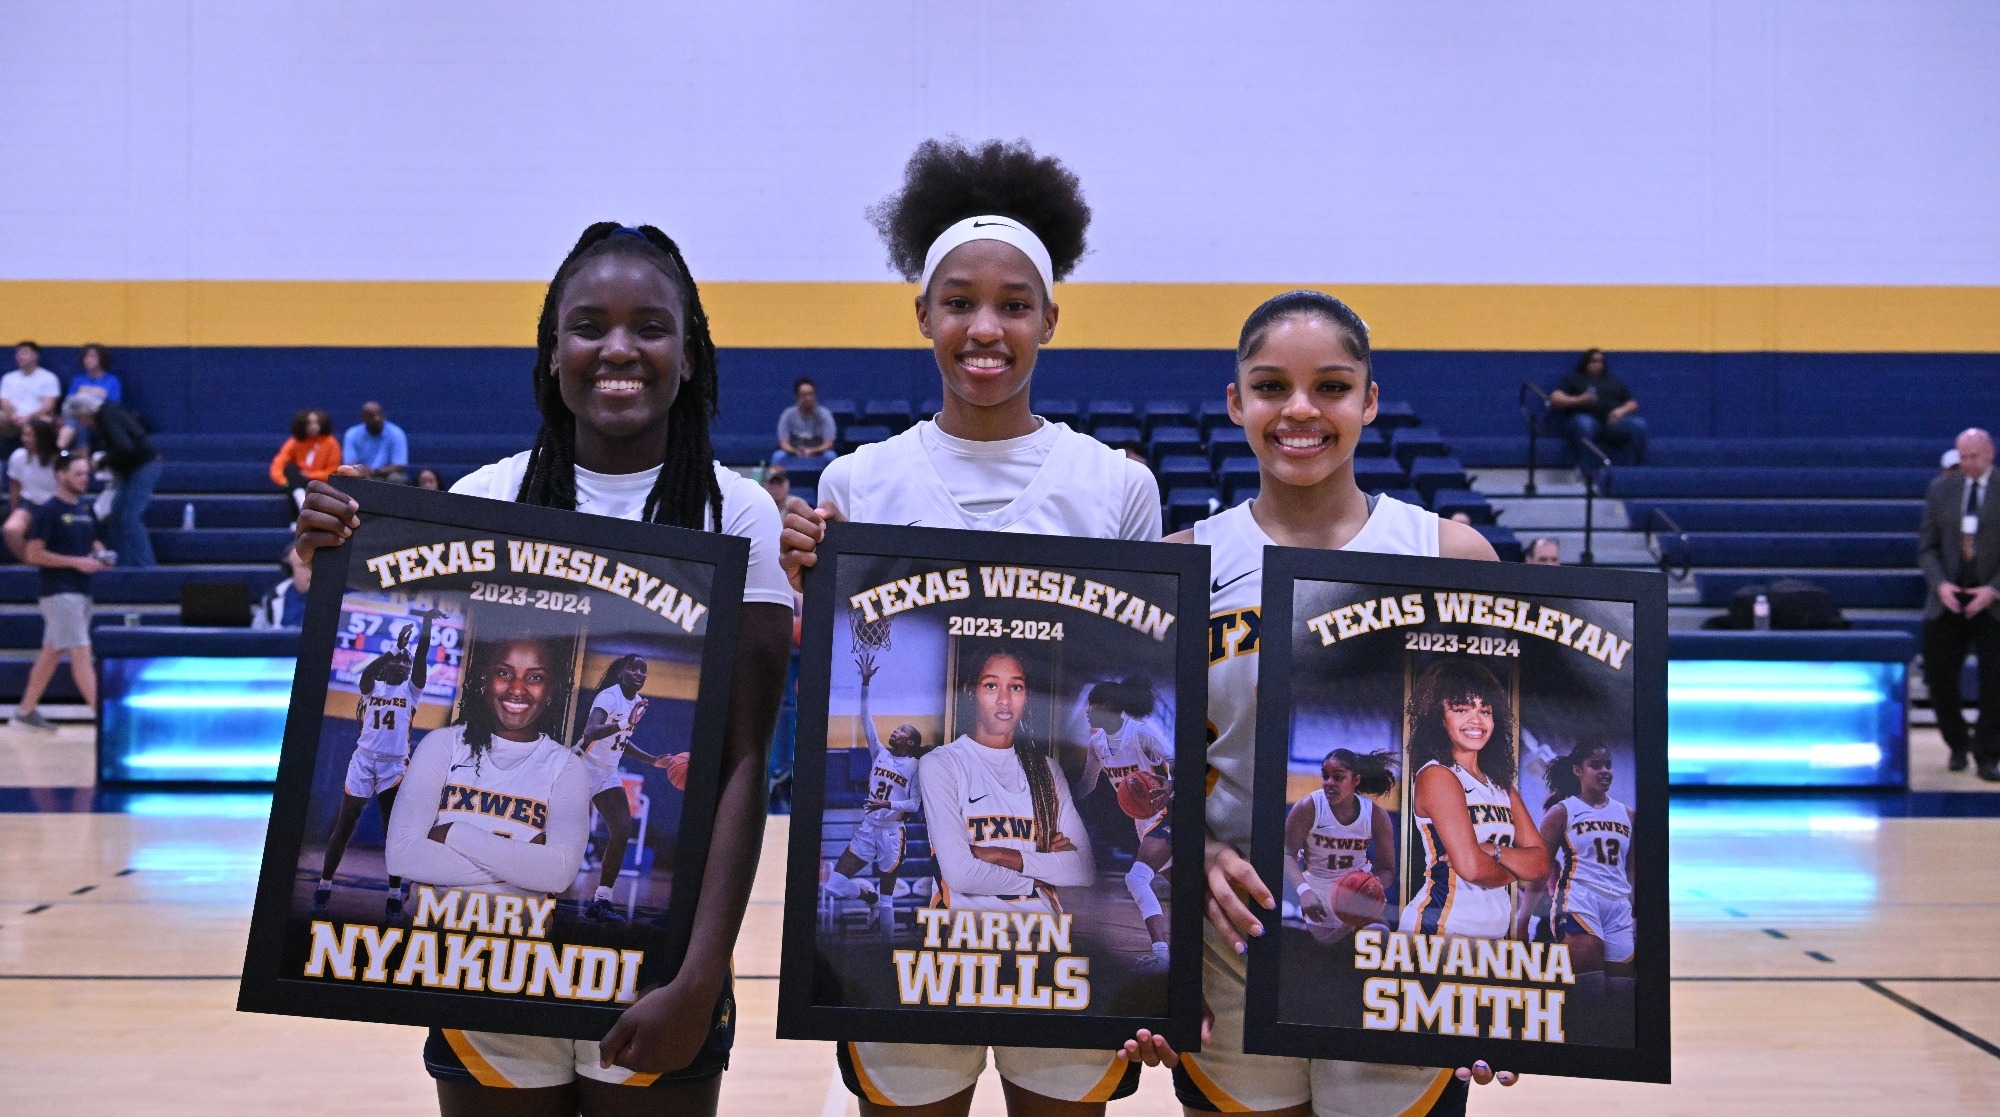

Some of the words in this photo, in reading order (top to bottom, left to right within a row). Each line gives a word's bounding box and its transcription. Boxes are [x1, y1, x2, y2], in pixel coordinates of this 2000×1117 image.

[367, 540, 495, 588] TEXAS
[508, 540, 706, 633] WESLEYAN
[470, 581, 591, 614] 2023-2024
[850, 568, 969, 623] TEXAS
[979, 567, 1176, 642] WESLEYAN
[348, 612, 383, 636] 57
[949, 616, 1064, 641] 2023-2024
[1307, 593, 1425, 647] TEXAS
[1433, 592, 1632, 670] WESLEYAN
[1405, 632, 1520, 657] 2023-2024
[373, 709, 395, 731] 14
[874, 766, 908, 788] TXWES
[876, 781, 893, 800] 21
[438, 783, 548, 832] TXWES
[1572, 820, 1630, 838] TXWES
[1594, 837, 1620, 866] 12
[413, 886, 556, 938] MARY
[916, 908, 1072, 953] TARYN
[304, 920, 644, 1004] NYAKUNDI
[1354, 929, 1576, 984] SAVANNA
[893, 949, 1090, 1010] WILLS
[1363, 977, 1565, 1043] SMITH
